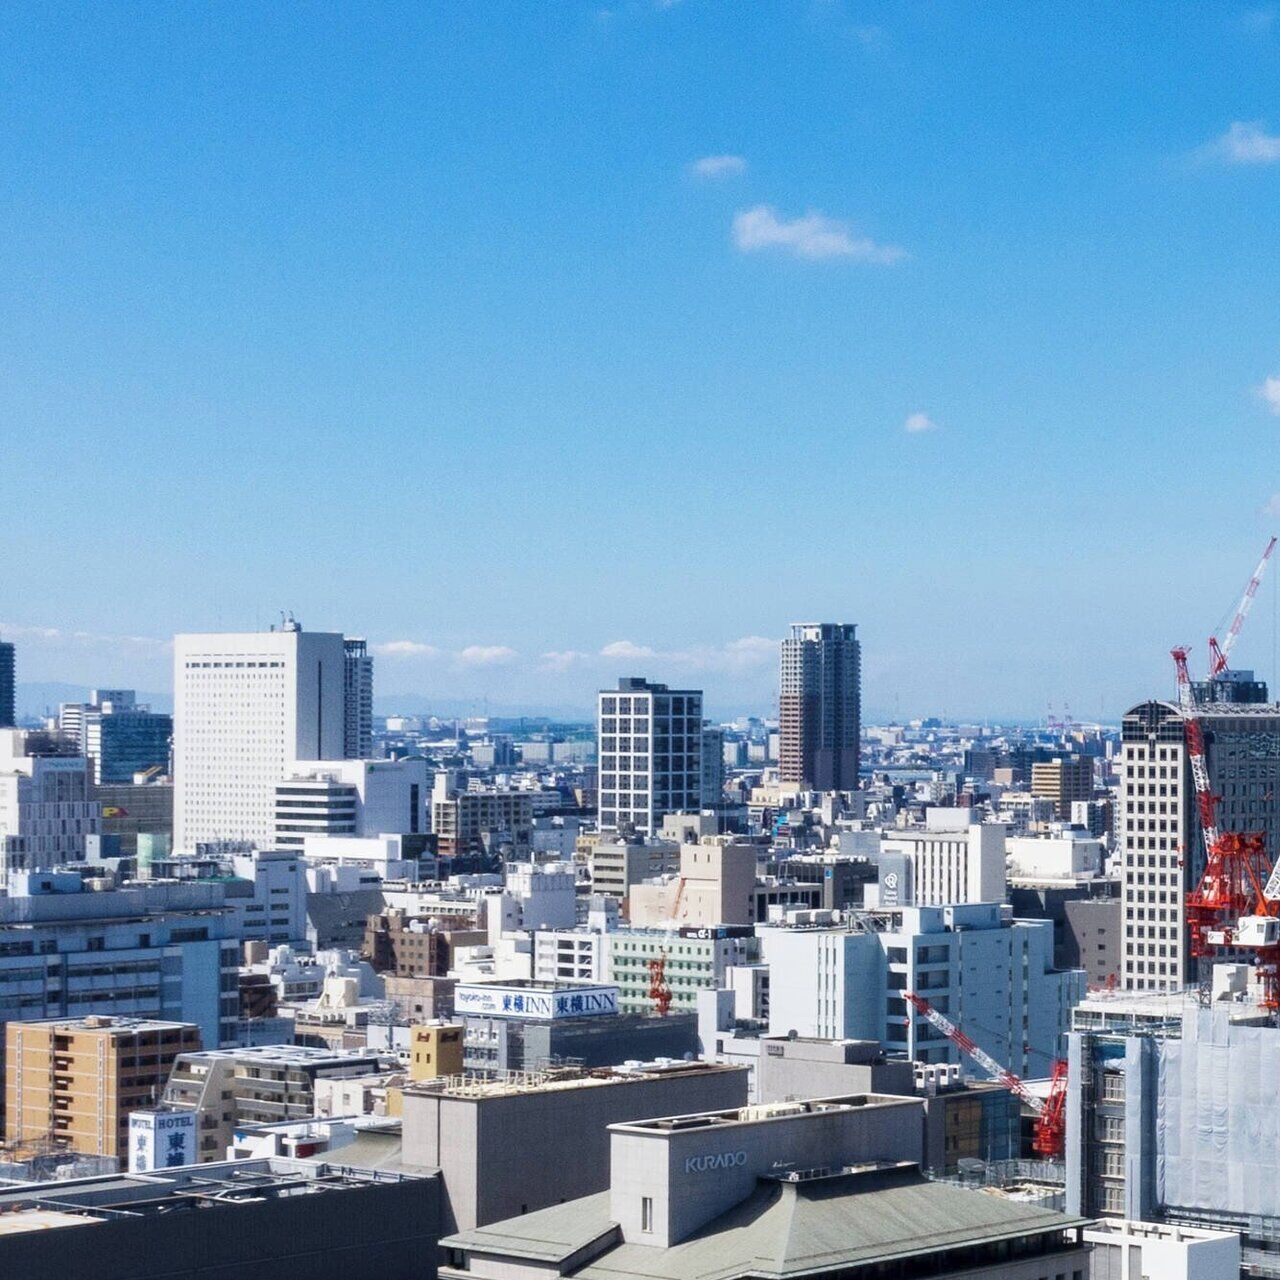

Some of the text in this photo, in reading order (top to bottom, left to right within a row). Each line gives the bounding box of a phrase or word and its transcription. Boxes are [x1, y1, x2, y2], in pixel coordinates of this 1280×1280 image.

[502, 994, 550, 1014] 東横INN
[556, 992, 616, 1014] 東横INN
[158, 1116, 193, 1129] HOTEL
